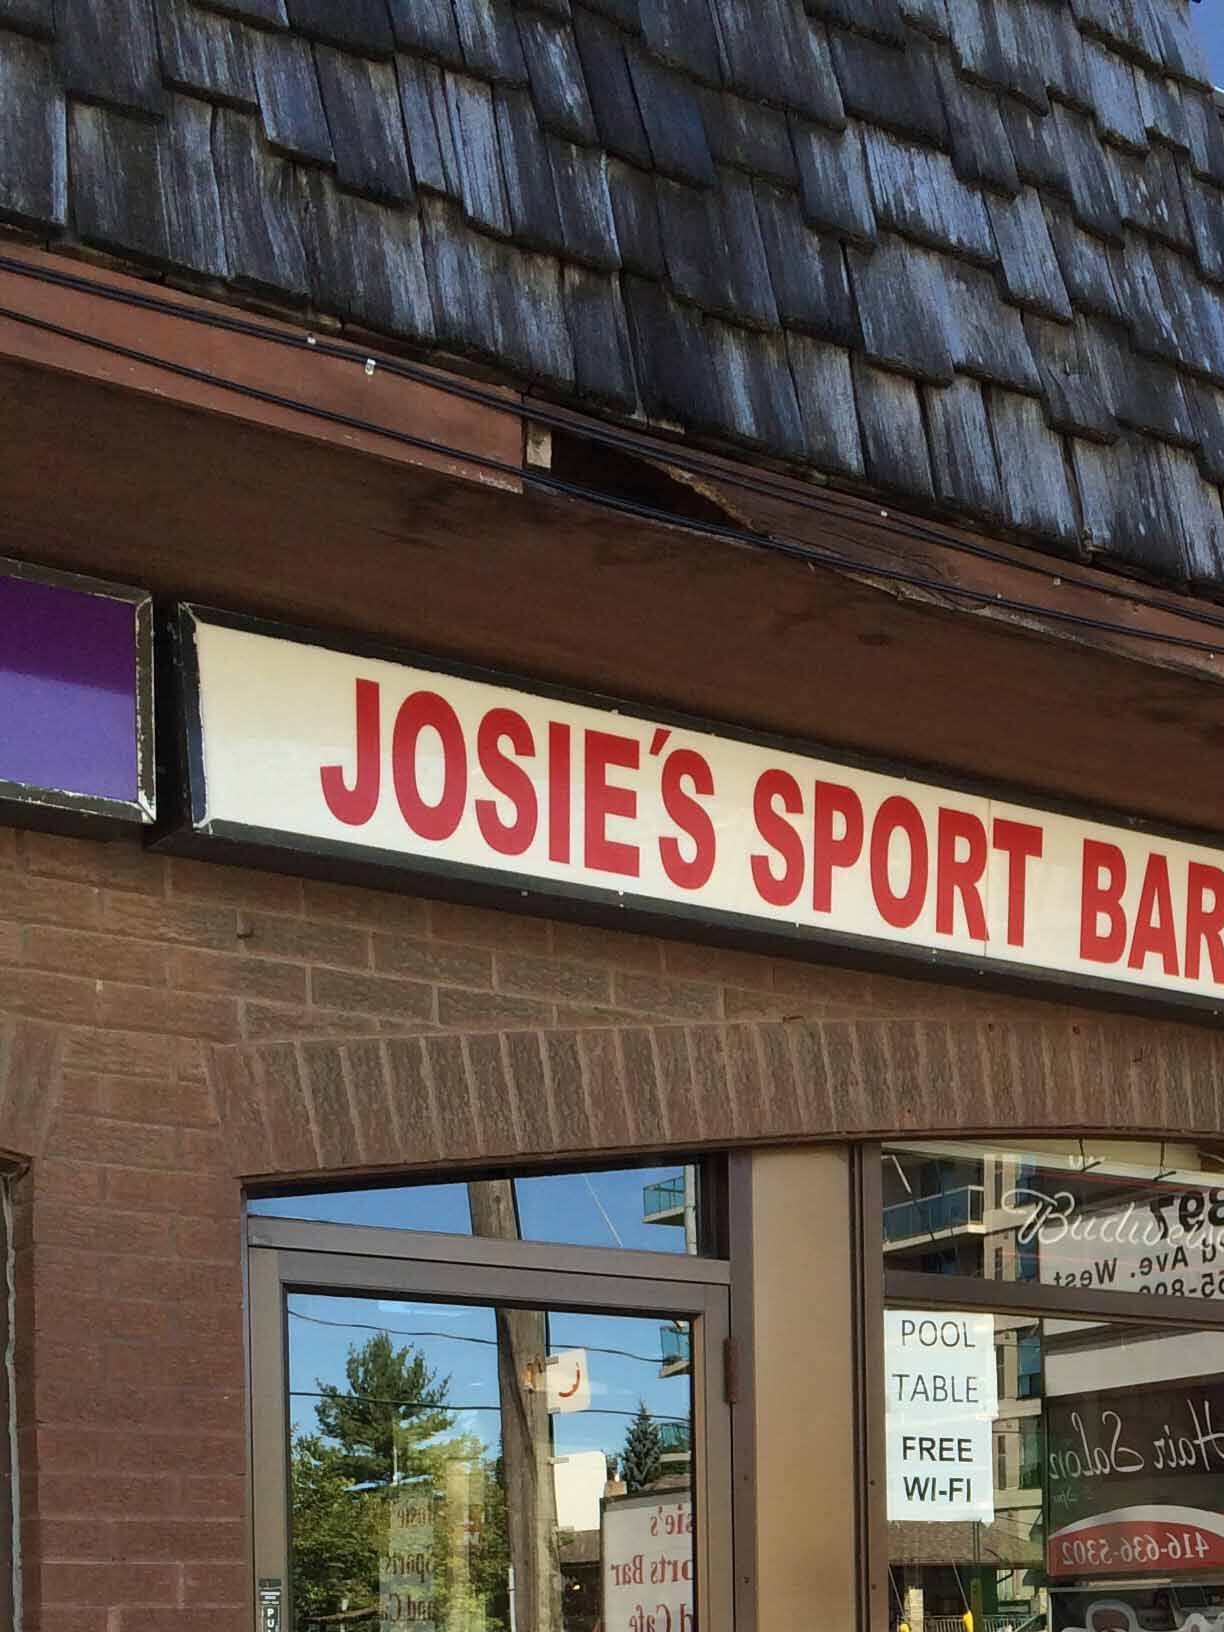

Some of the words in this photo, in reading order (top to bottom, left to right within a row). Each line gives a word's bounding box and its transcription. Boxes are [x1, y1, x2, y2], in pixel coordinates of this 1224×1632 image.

[319, 677, 717, 891] JOSIE'S
[750, 767, 1044, 948] SPORT
[900, 1318, 977, 1349] POOL
[892, 1373, 980, 1405] TABLE
[902, 1435, 974, 1464] FREE
[903, 1475, 973, 1505] WI-FI
